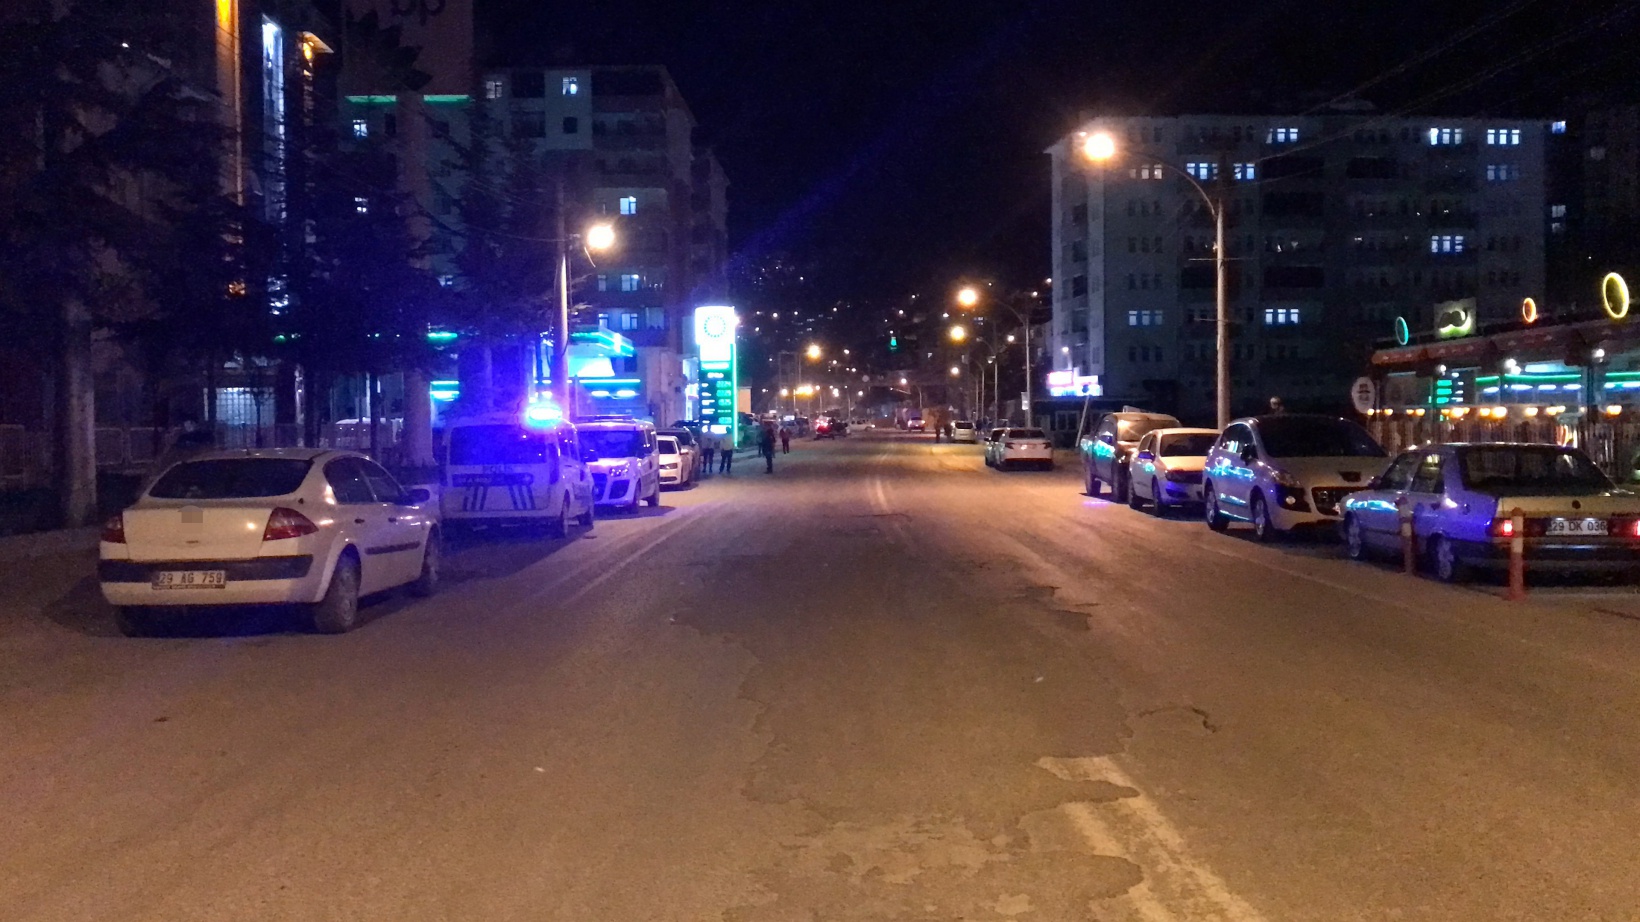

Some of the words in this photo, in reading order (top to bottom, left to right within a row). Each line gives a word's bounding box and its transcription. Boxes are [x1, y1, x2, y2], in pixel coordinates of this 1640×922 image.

[1552, 521, 1565, 531] 29
[1568, 521, 1583, 531] DK
[1587, 521, 1606, 531] 036
[159, 572, 174, 584] 29
[180, 572, 194, 584] AG
[202, 571, 222, 584] 759
